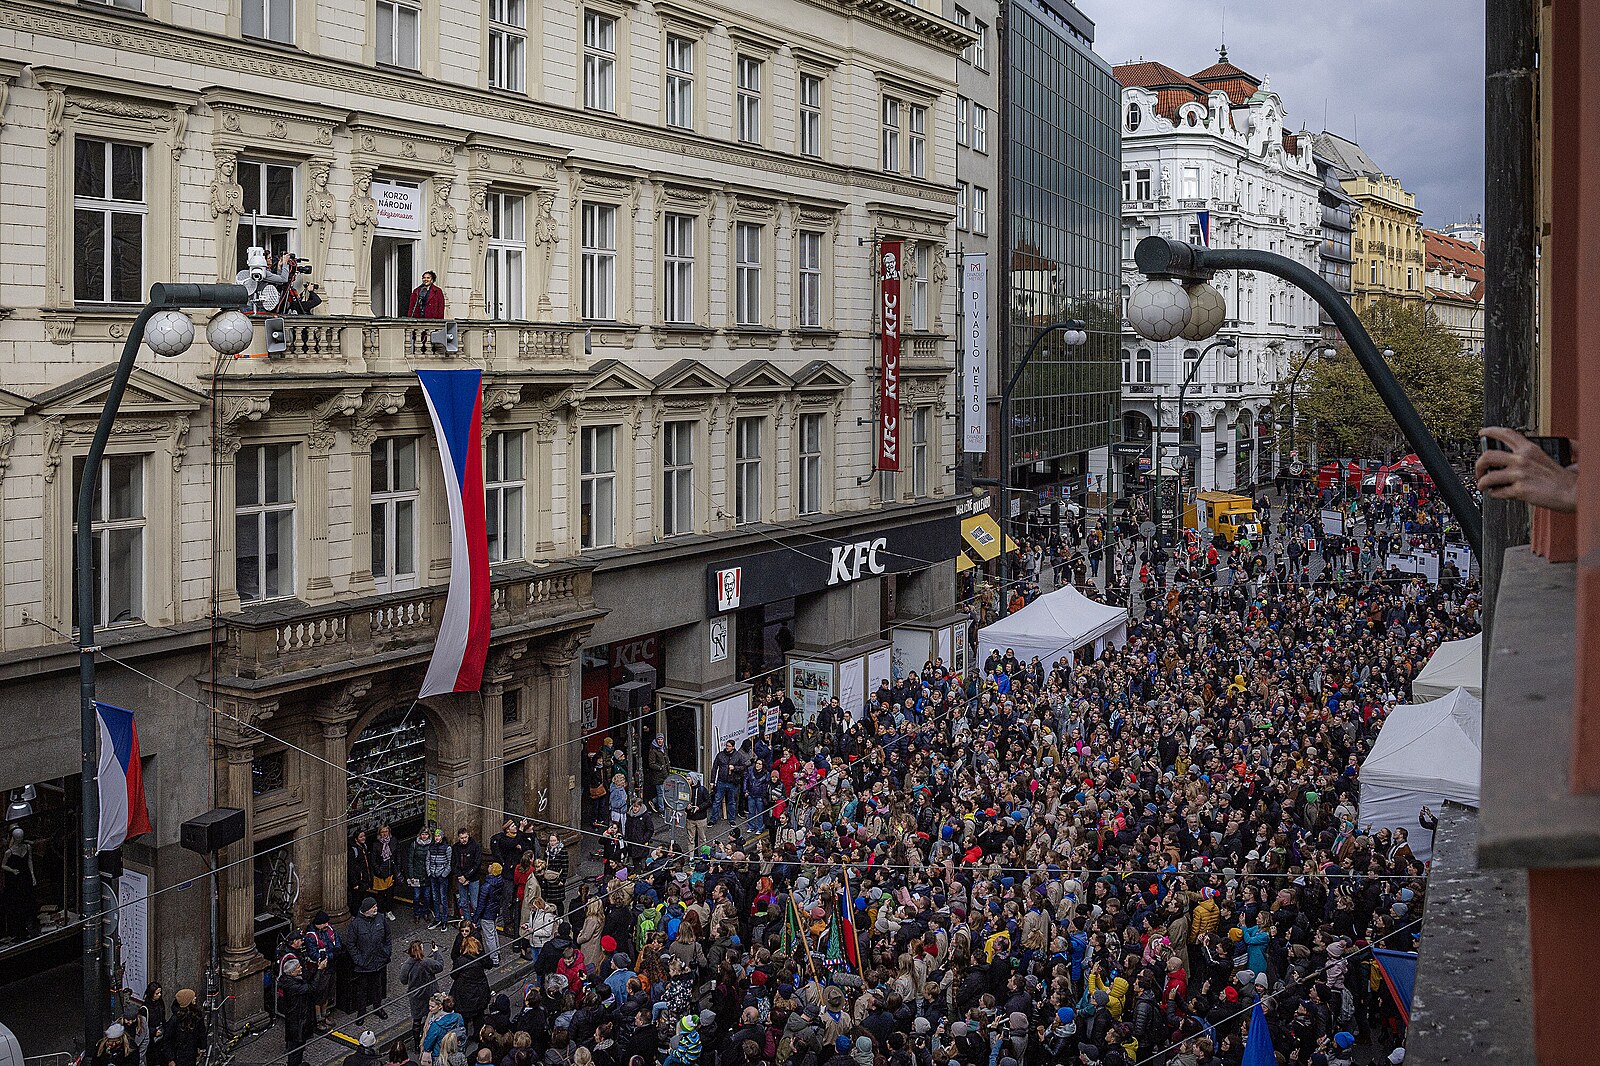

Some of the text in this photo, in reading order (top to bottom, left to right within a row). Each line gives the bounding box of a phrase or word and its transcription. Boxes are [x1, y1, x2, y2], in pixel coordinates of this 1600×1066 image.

[378, 198, 413, 211] NÁRODNÍ
[383, 190, 409, 201] KORZO
[885, 291, 897, 339] KFC
[972, 291, 980, 412] DIVADLO METRO
[885, 353, 897, 400] KFC
[883, 412, 896, 462] KFC
[826, 537, 887, 586] KFC
[613, 637, 656, 668] KFC
